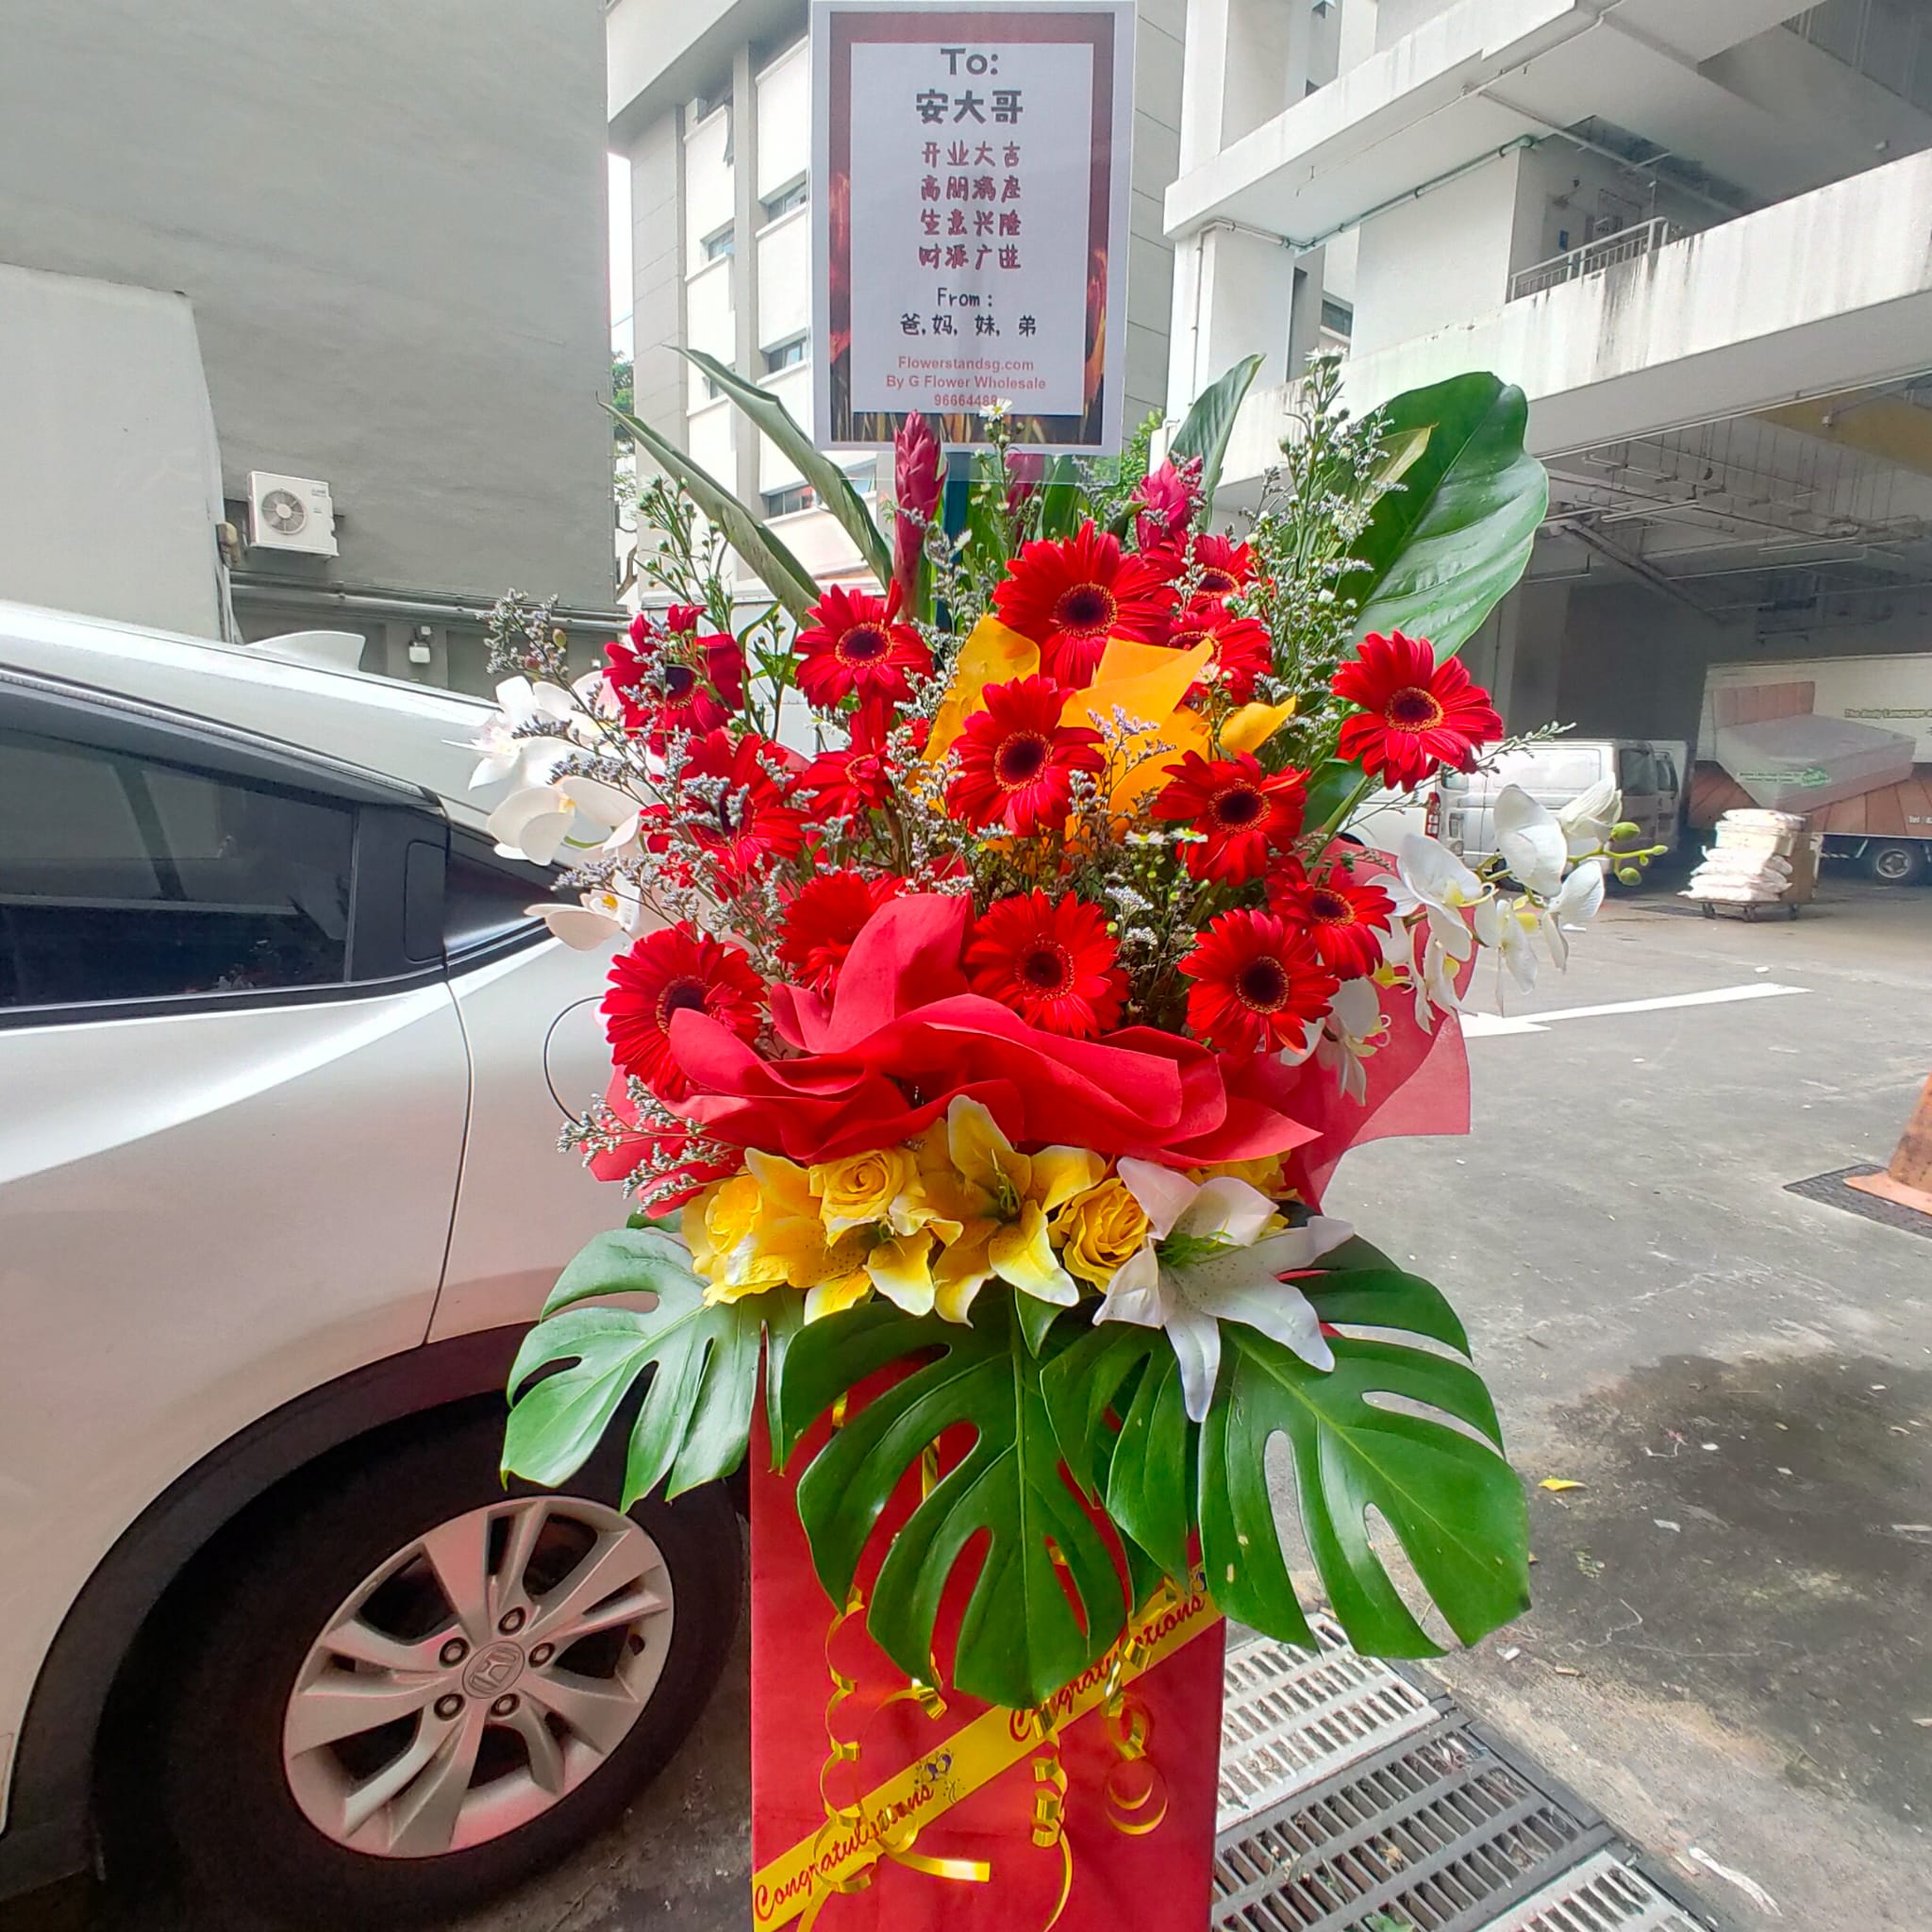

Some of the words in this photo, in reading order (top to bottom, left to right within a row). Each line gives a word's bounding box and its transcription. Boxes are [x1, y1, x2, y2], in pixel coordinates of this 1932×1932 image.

[941, 48, 998, 75] To:
[916, 89, 1024, 125] 安大哥
[921, 141, 1021, 169] 开业大吉
[921, 175, 1021, 203] 高朋满座
[920, 208, 1022, 237] 生意兴隆
[919, 243, 1022, 270] 财源广进
[898, 356, 1034, 373] Flowerstandsg.com
[886, 375, 905, 390] By
[908, 375, 920, 388] G
[924, 375, 971, 389] Flower
[974, 375, 1046, 390] Wholesale
